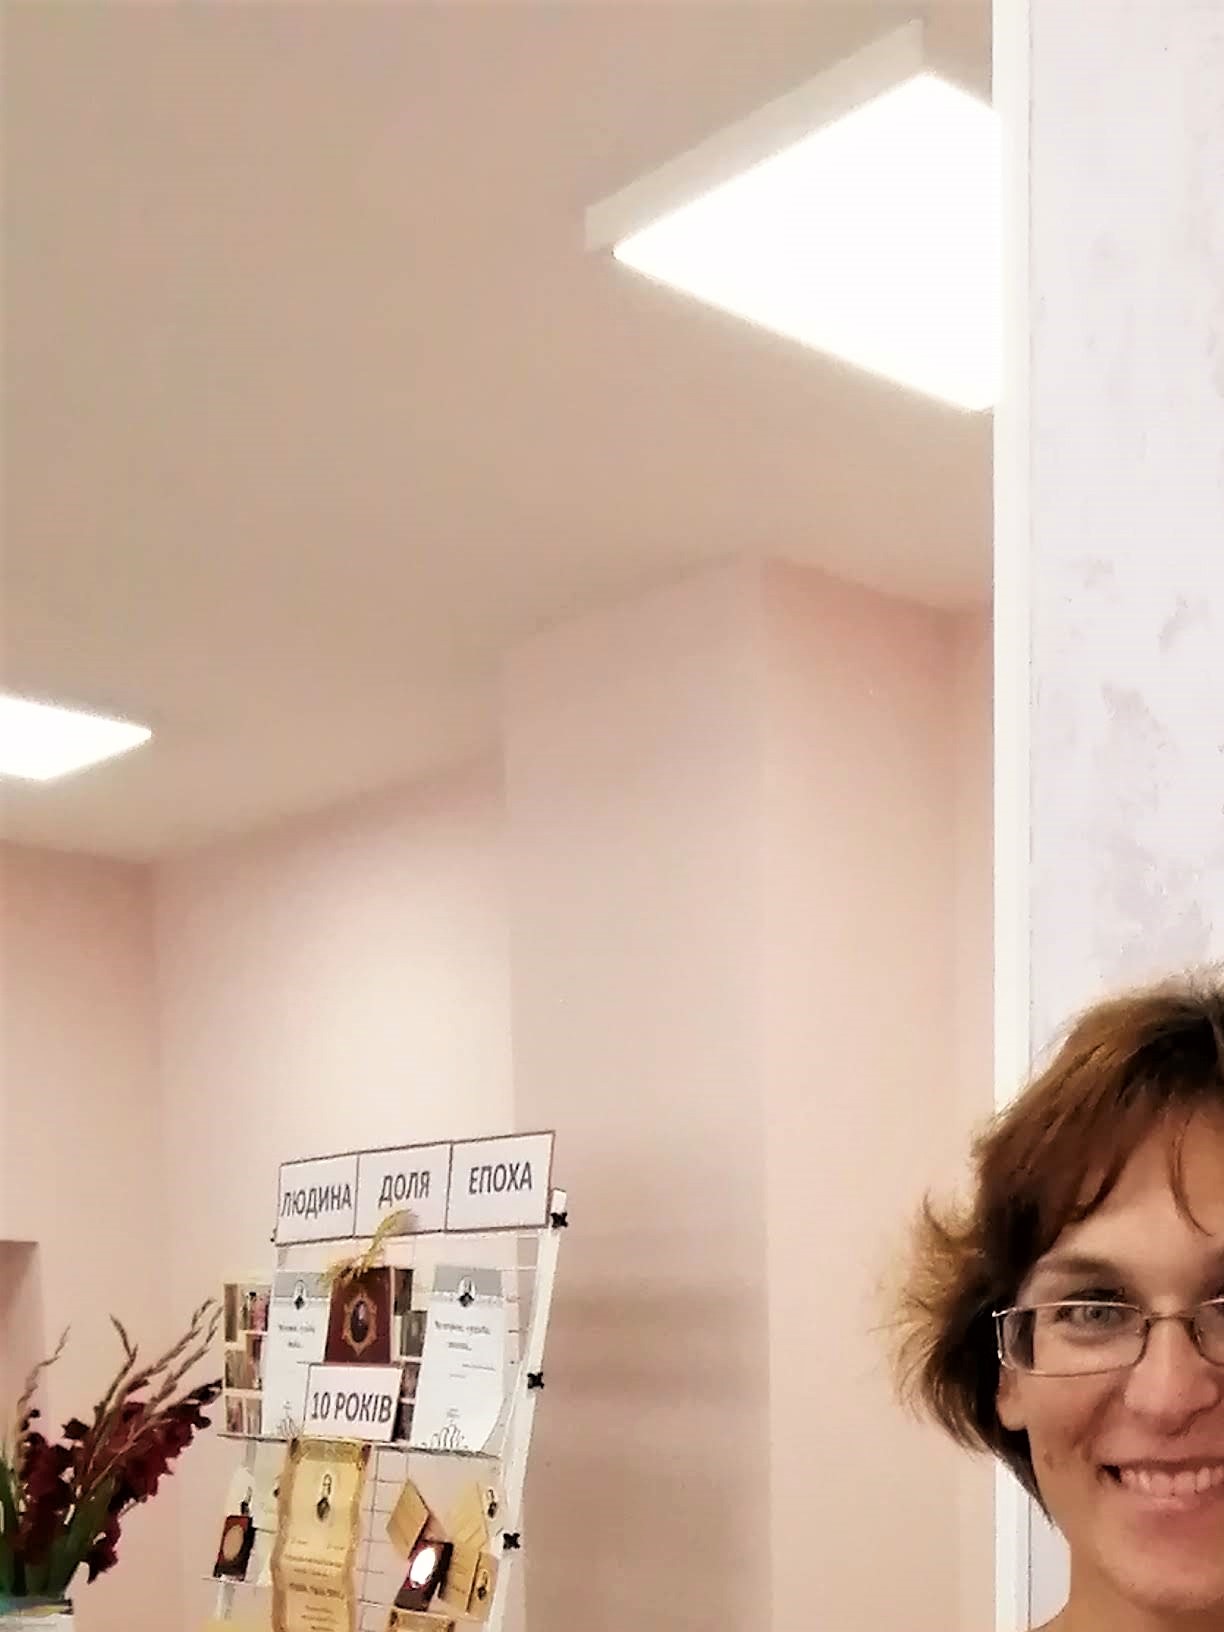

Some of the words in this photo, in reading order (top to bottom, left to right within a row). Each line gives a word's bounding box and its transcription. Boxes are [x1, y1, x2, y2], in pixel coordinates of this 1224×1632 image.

[281, 1183, 352, 1219] ЛЮДИНА
[379, 1171, 431, 1208] ДОЛЯ
[468, 1162, 533, 1195] ЕПОХА
[311, 1392, 330, 1419] 10
[334, 1393, 393, 1423] РОКІВ
